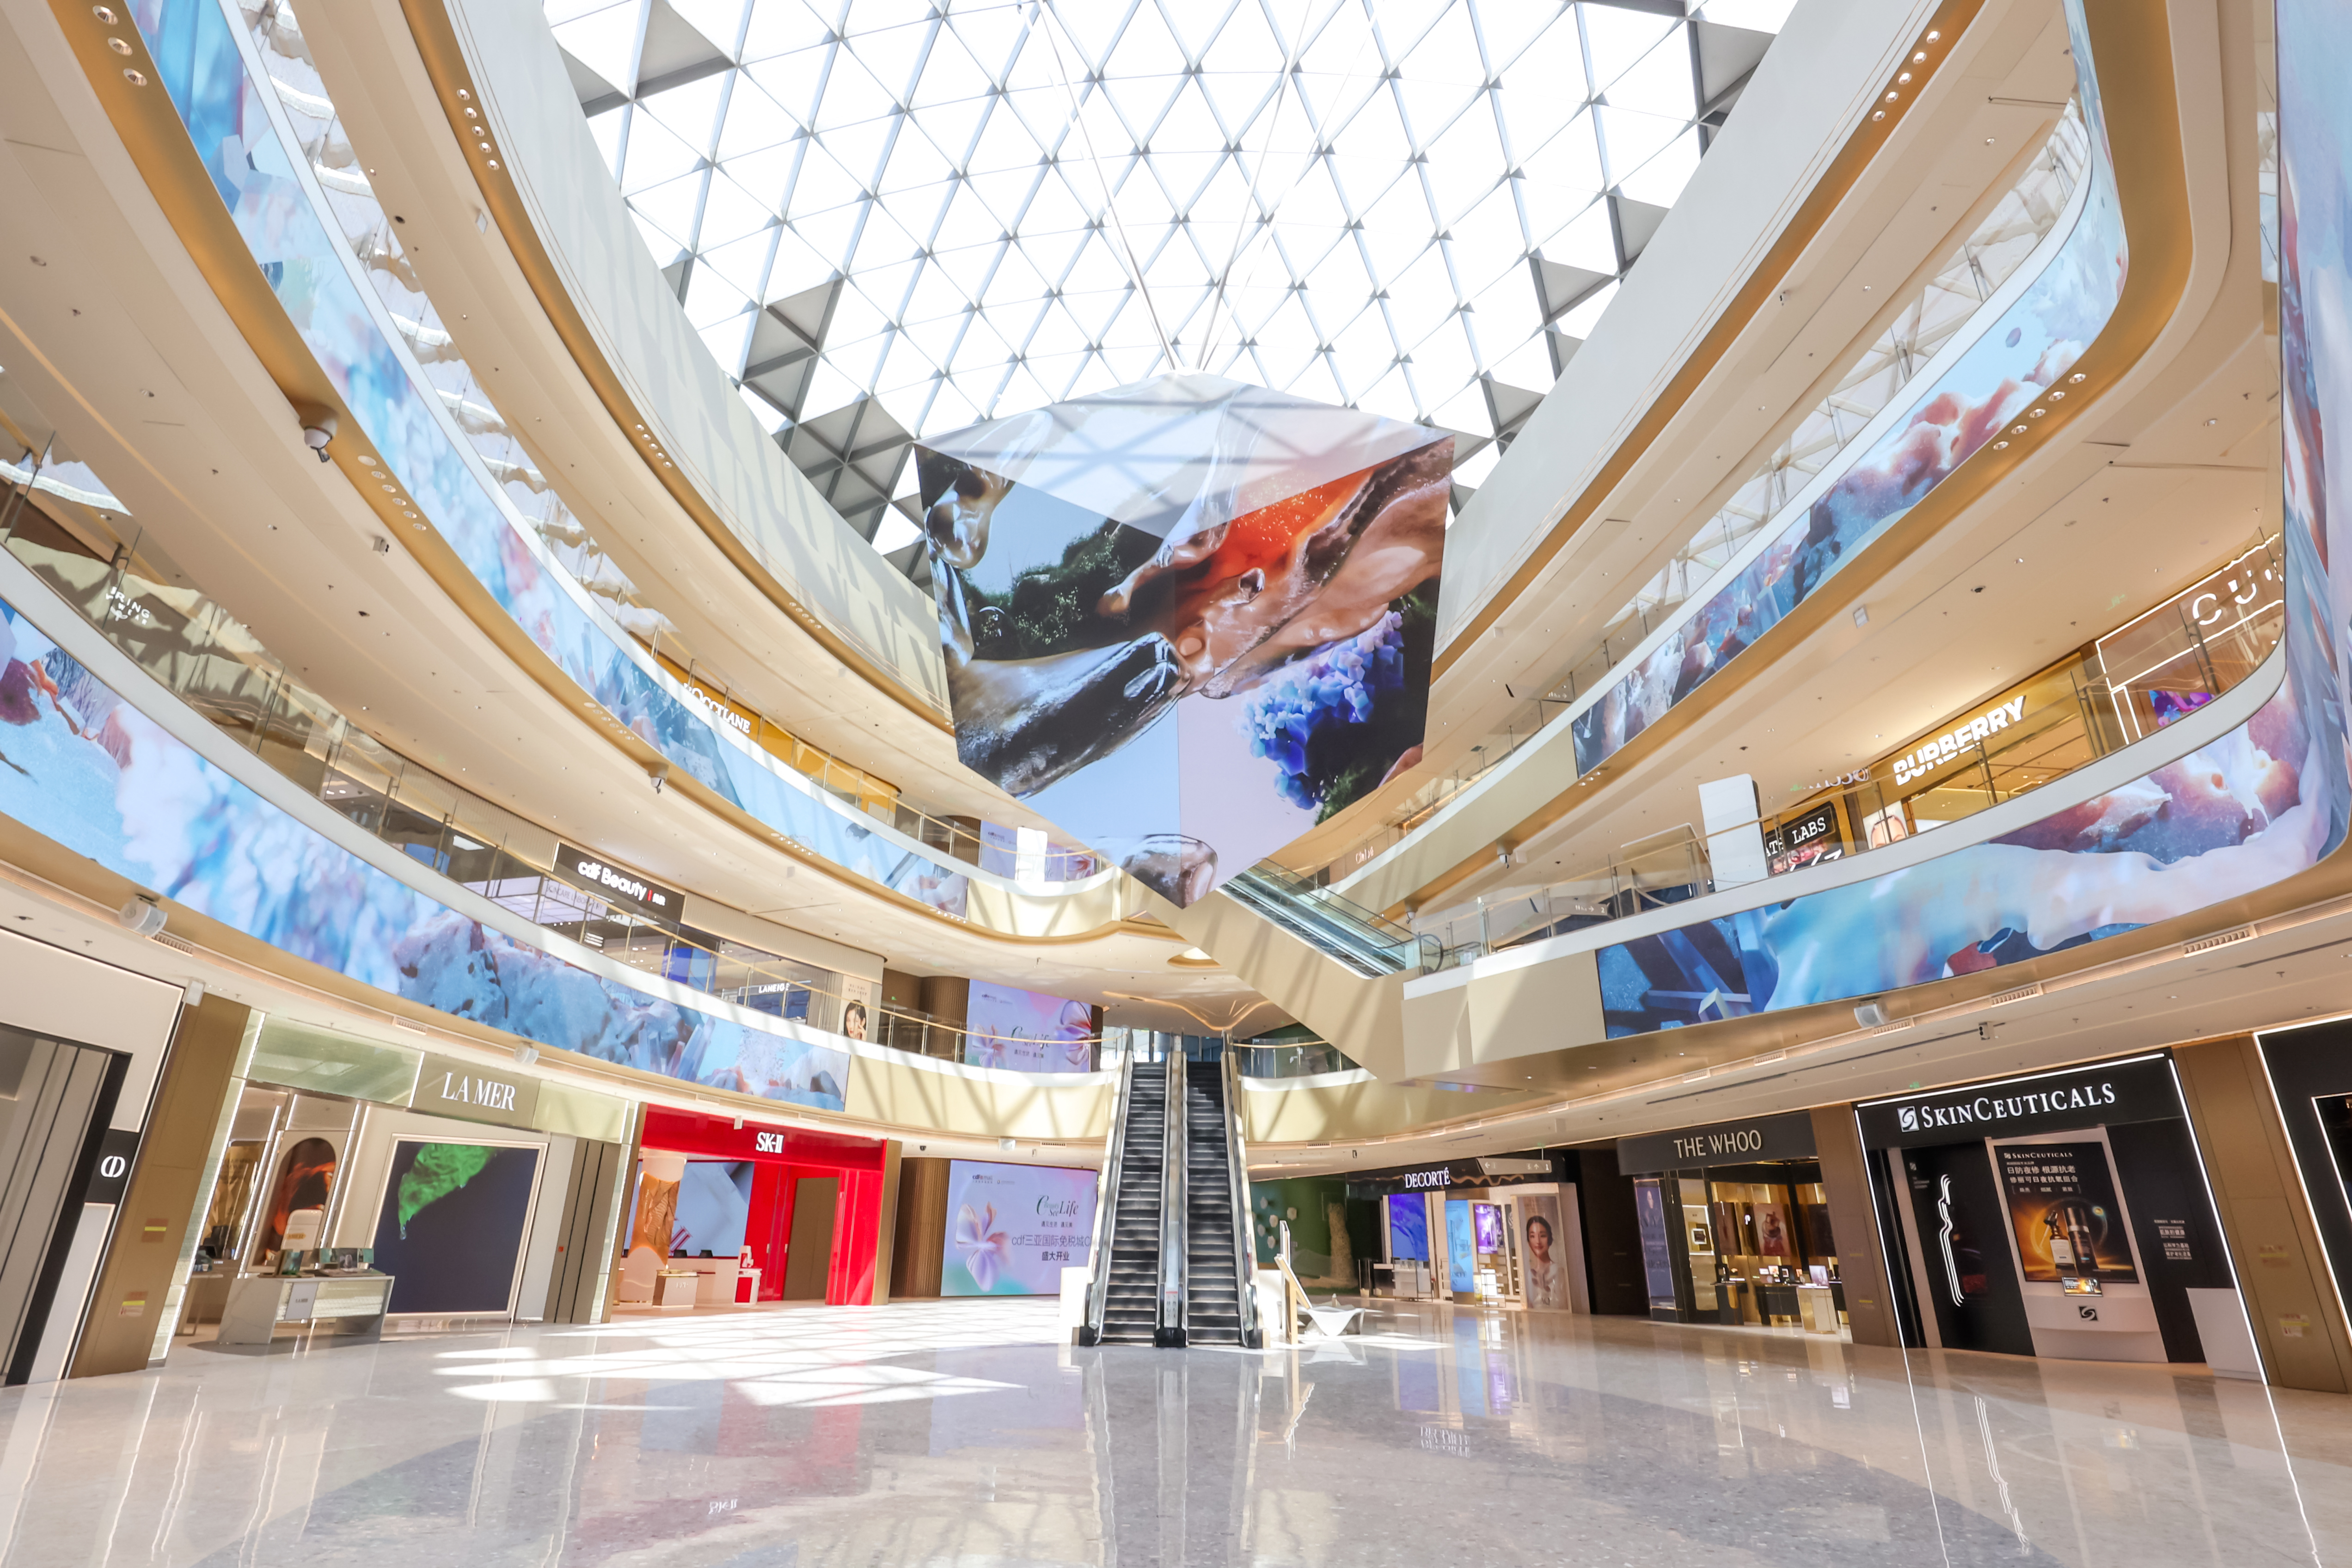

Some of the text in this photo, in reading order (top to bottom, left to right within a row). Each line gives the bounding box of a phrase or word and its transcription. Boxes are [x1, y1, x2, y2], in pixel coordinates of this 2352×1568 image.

[1893, 695, 2025, 786] BURBERRY
[1792, 817, 1826, 844] LABS
[578, 861, 602, 880] cdf
[601, 867, 647, 901] Beauty
[441, 1072, 516, 1111] LA MER
[756, 1132, 784, 1153] SK-II
[1673, 1129, 1762, 1158] THE WHOO
[1405, 1167, 1451, 1188] DECORTÉ
[1060, 1200, 1078, 1217] Life
[1011, 1235, 1091, 1247] cdf三亚国际免税城C
[1042, 1251, 1069, 1261] 盛大开业
